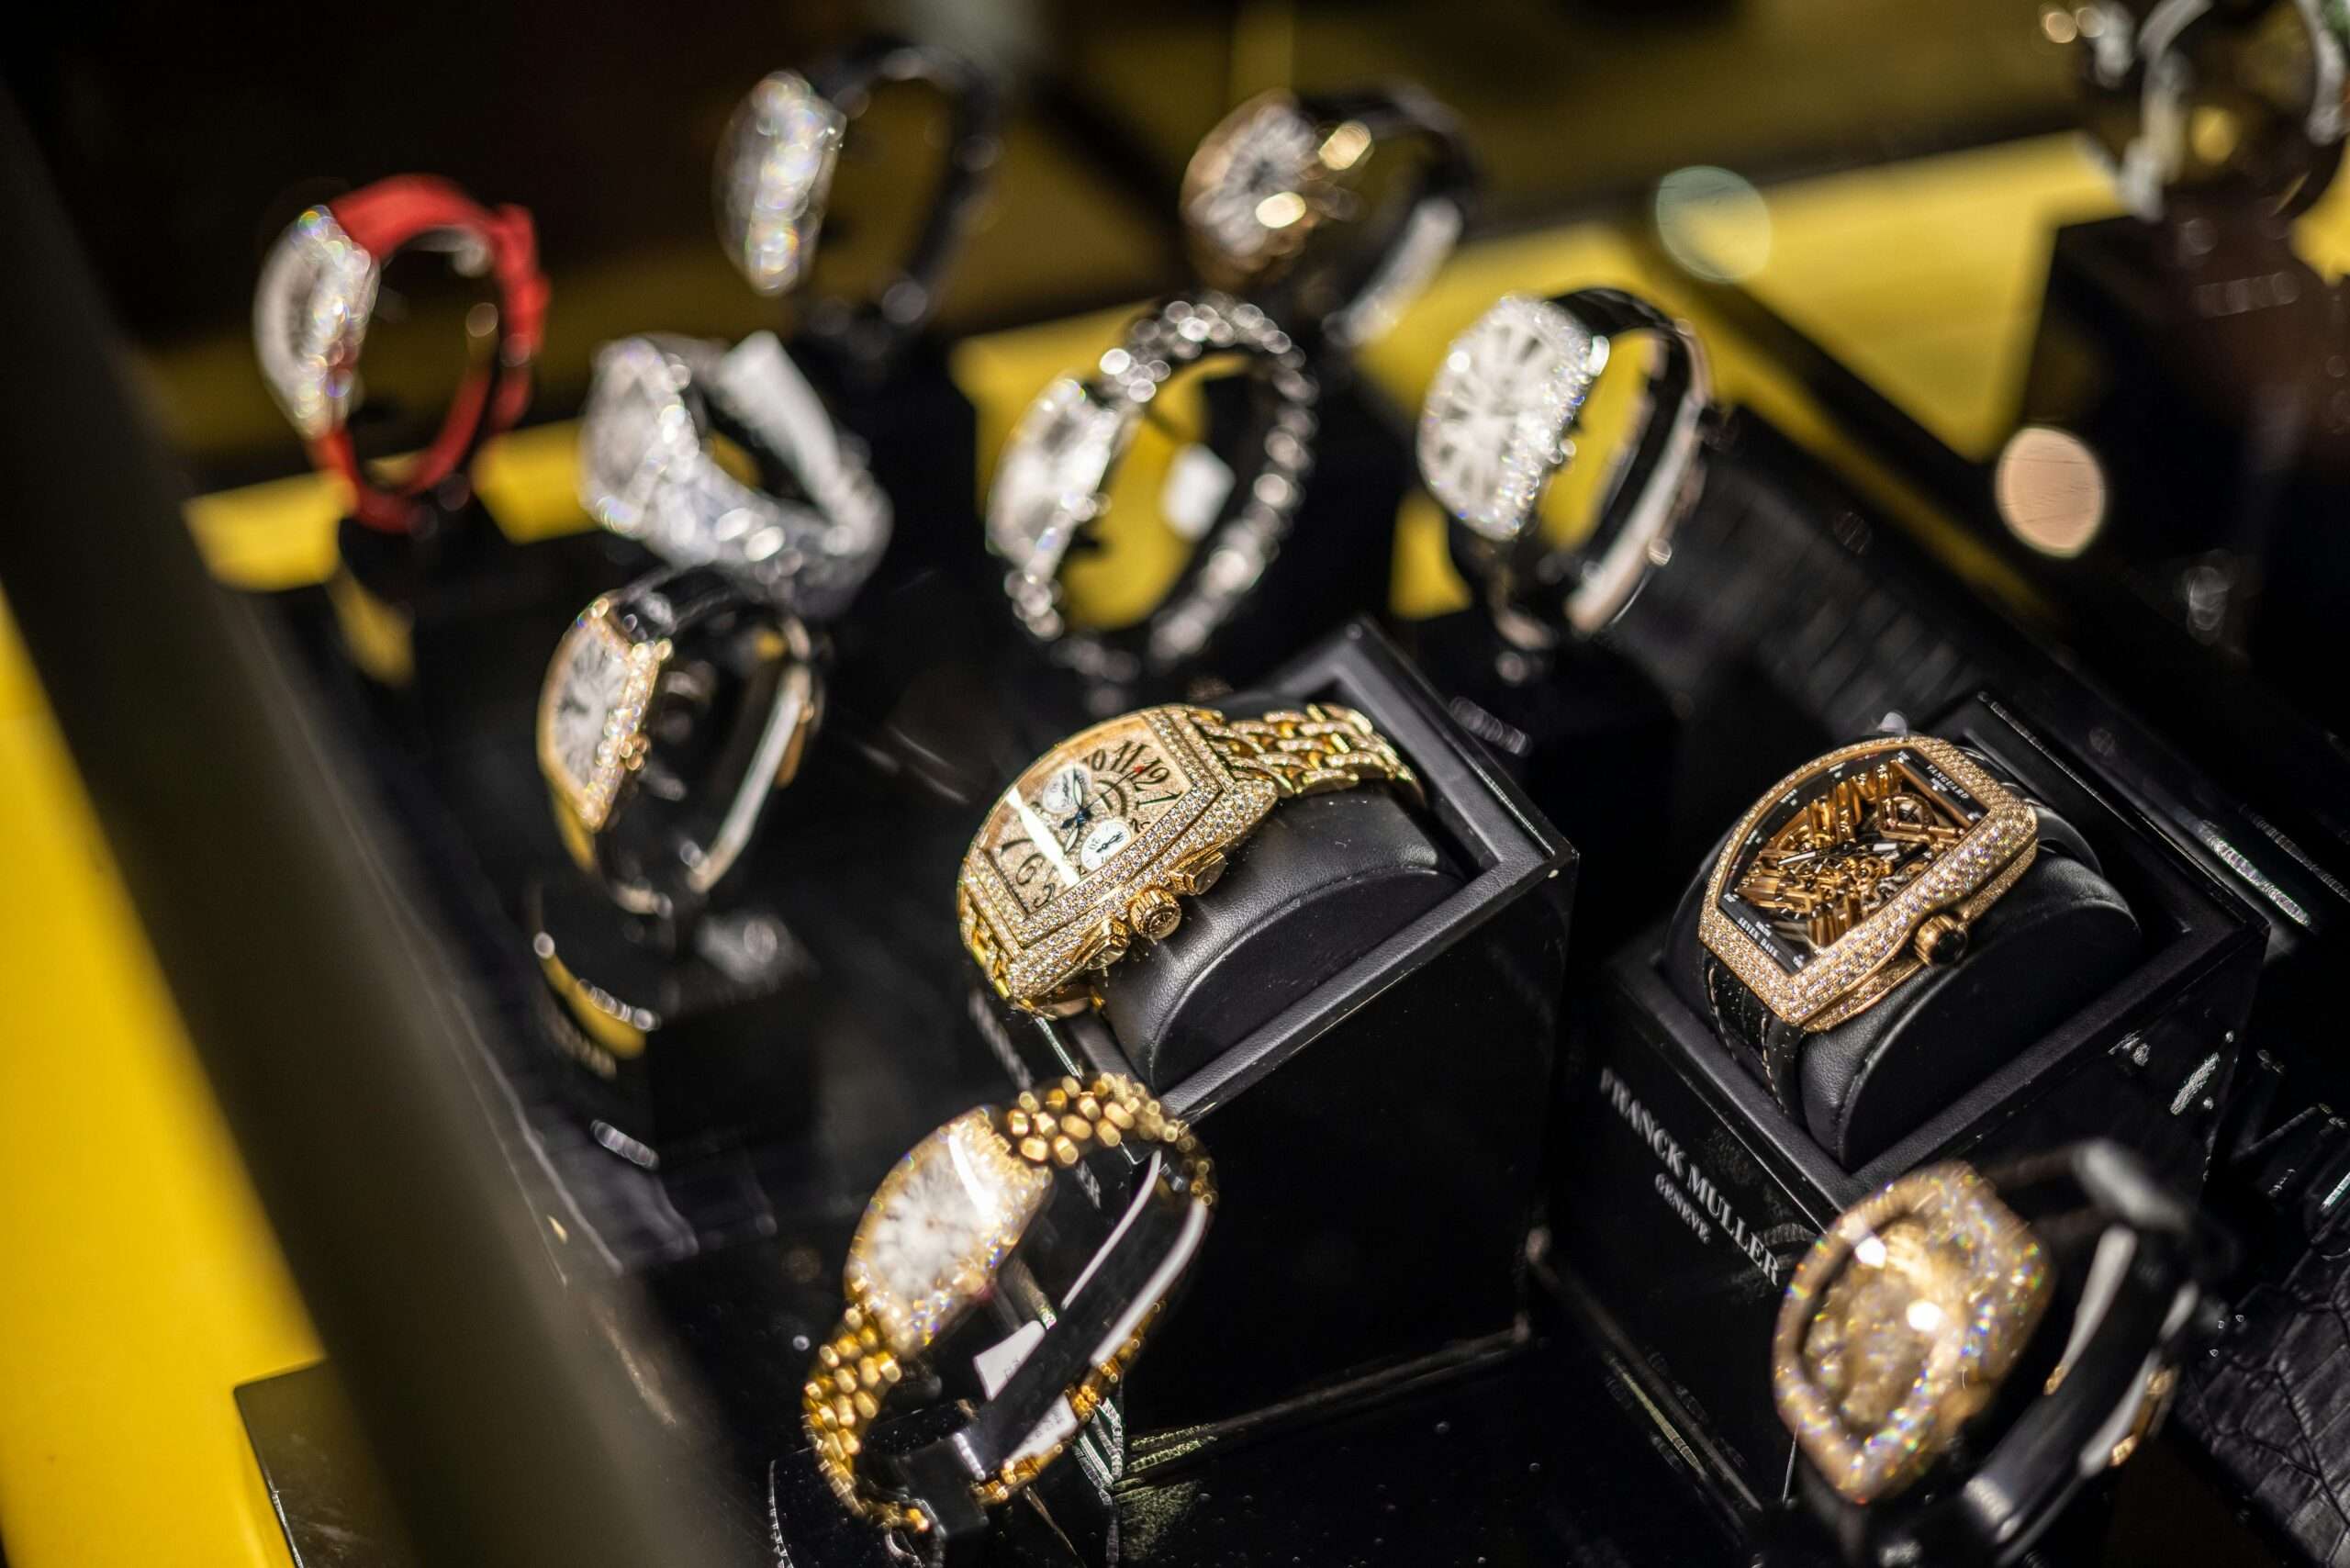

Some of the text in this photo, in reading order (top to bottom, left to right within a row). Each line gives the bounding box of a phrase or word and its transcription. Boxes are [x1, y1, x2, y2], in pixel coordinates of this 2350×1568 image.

[1926, 764, 1970, 799] VANGUARD
[1599, 1067, 1780, 1286] FRANCK MULLER
